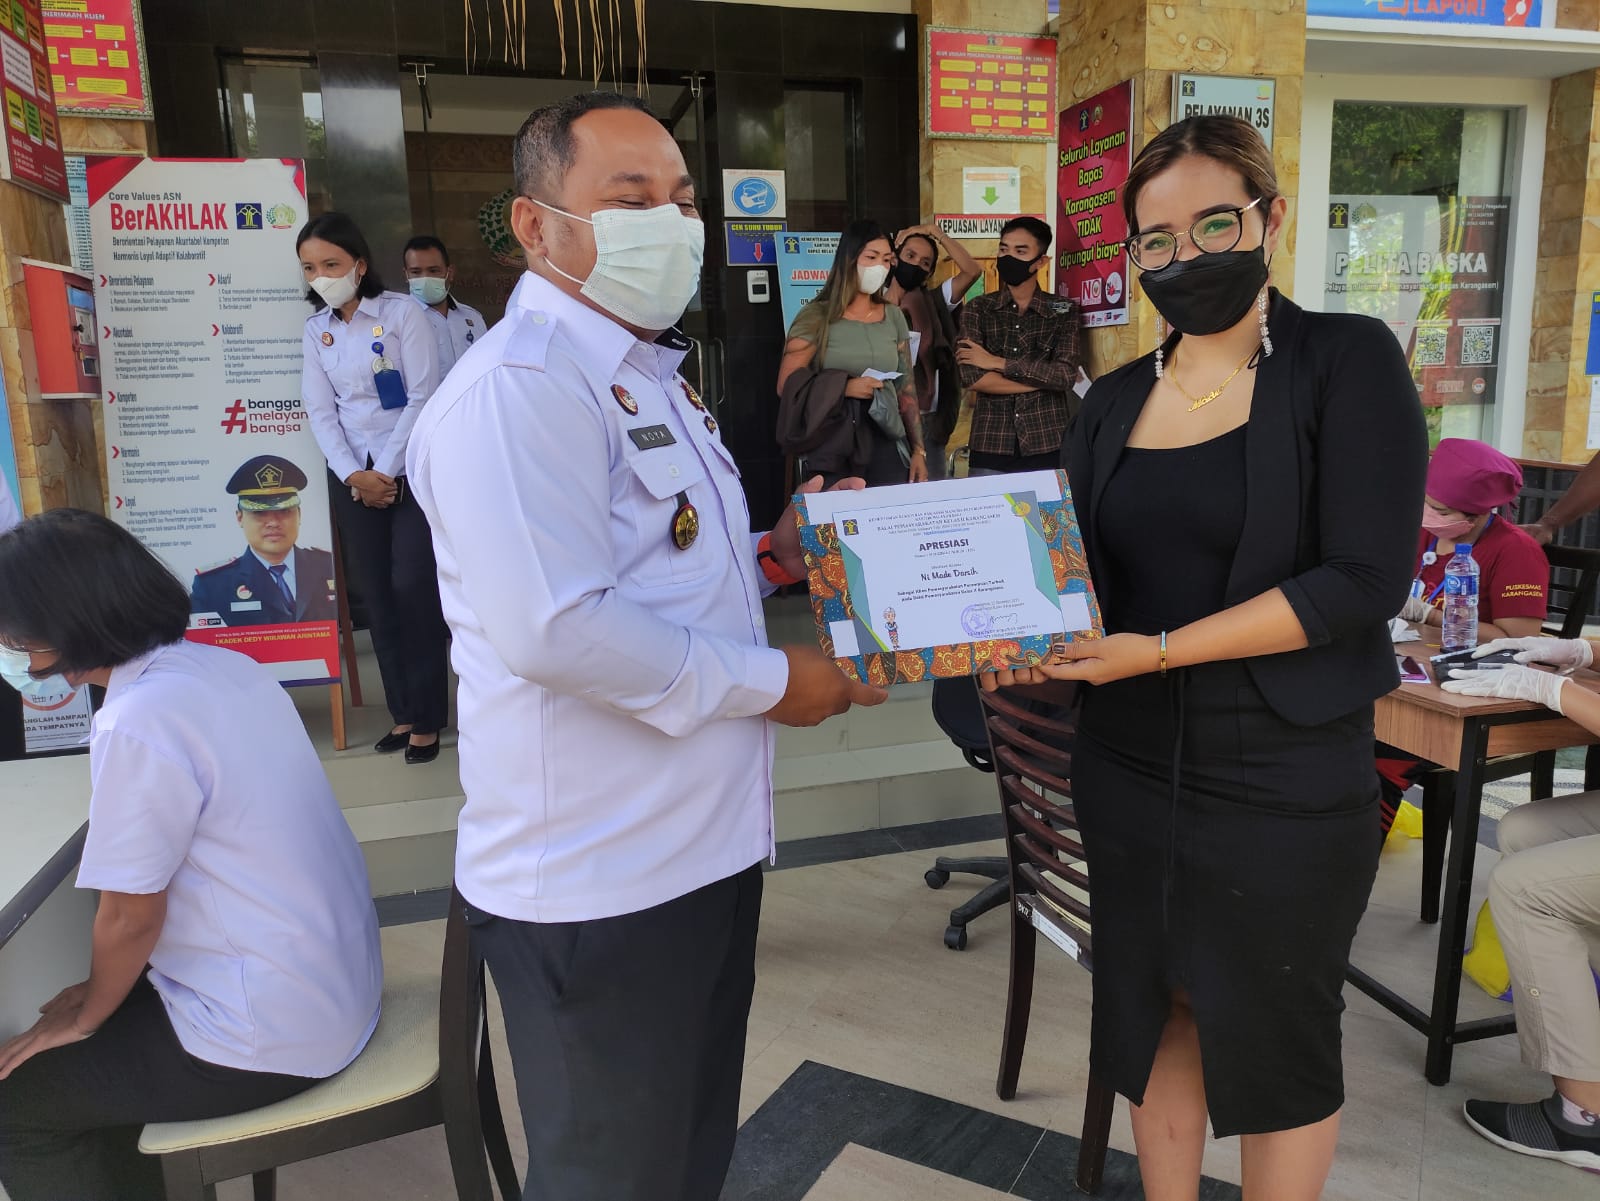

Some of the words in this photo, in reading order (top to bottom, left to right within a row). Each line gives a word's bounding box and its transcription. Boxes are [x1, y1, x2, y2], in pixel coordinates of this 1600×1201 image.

[1255, 107, 1270, 128] 3S
[1060, 141, 1088, 167] Seluruh
[1090, 130, 1126, 159] Layanan
[1078, 166, 1103, 187] Bapas
[108, 192, 129, 201] Core
[131, 192, 160, 201] Values
[163, 192, 181, 201] ASN
[1065, 189, 1116, 216] Karangasem
[110, 203, 228, 230] BerAKHLAK
[938, 219, 978, 234] KEPUASAN
[1077, 216, 1102, 237] TIDAK
[1060, 245, 1094, 269] dipungut
[1096, 241, 1119, 261] biaya
[1335, 251, 1411, 276] PELITA
[1417, 251, 1488, 275] BASKA
[248, 399, 301, 412] bangga
[250, 423, 301, 436] bangsa
[641, 430, 666, 442] NOYA
[919, 538, 969, 552] APRESIASI
[920, 573, 930, 582] Ni
[931, 570, 952, 579] Made
[1501, 590, 1543, 598] KARANGASEM
[1505, 583, 1542, 591] PUSKESMAS
[38, 722, 85, 731] TEMPATNYA
